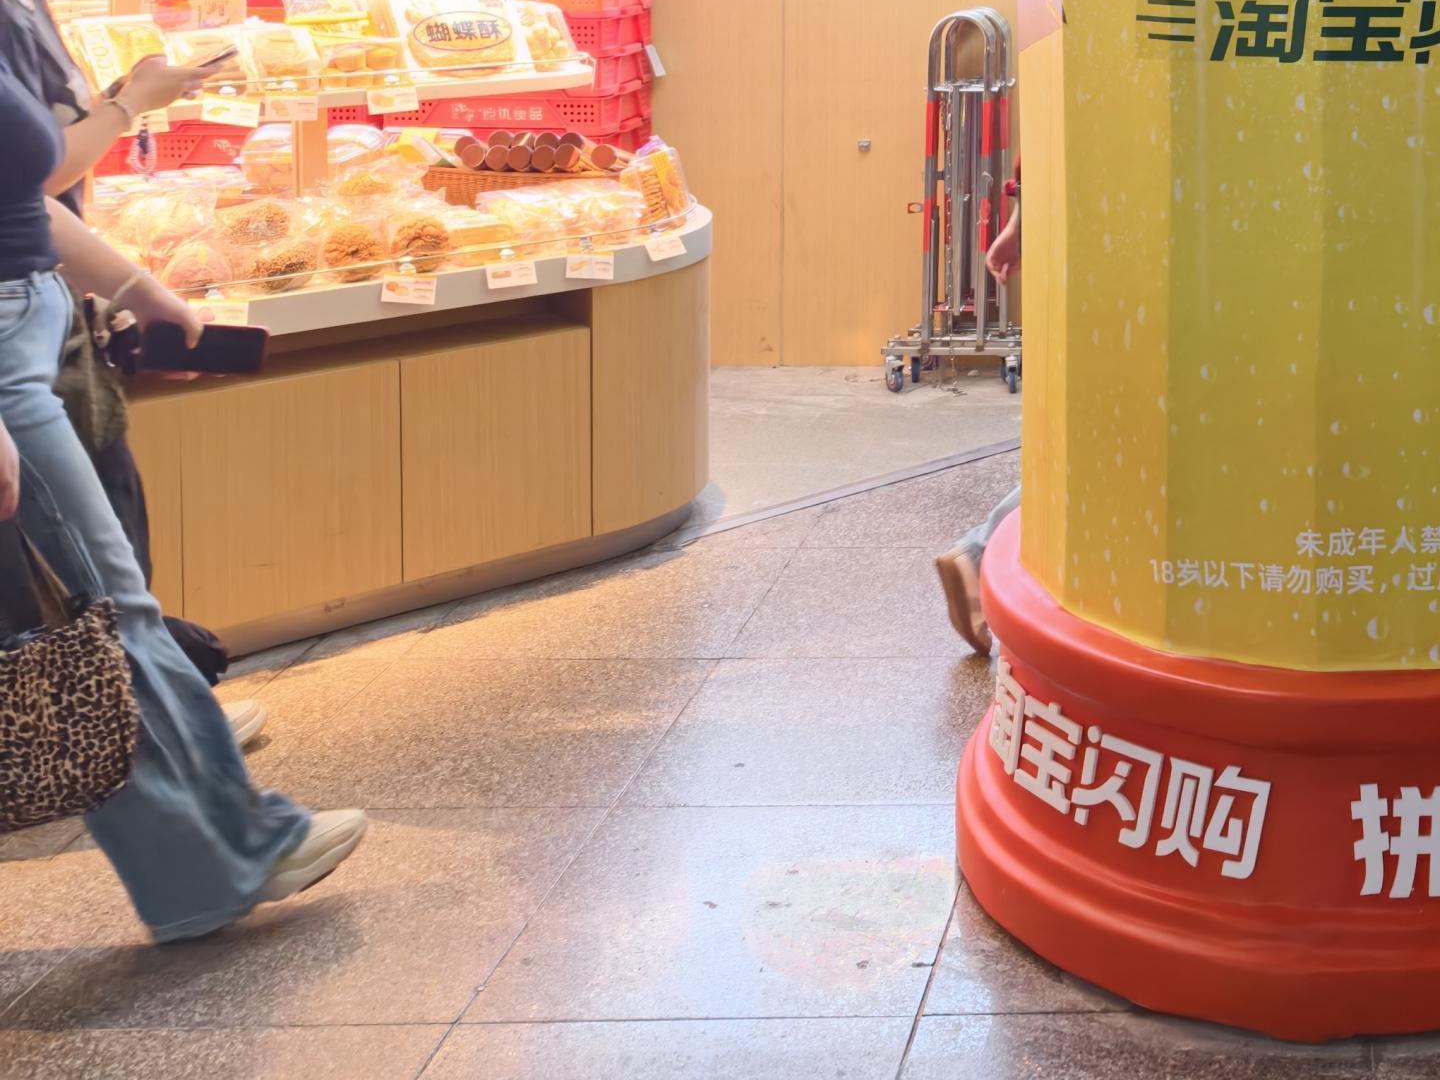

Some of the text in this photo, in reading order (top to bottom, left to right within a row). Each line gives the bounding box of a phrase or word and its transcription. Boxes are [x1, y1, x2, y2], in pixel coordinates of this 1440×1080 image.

[426, 19, 503, 43] 蝴蝶酥
[990, 656, 1273, 880] 淘宝闪购
